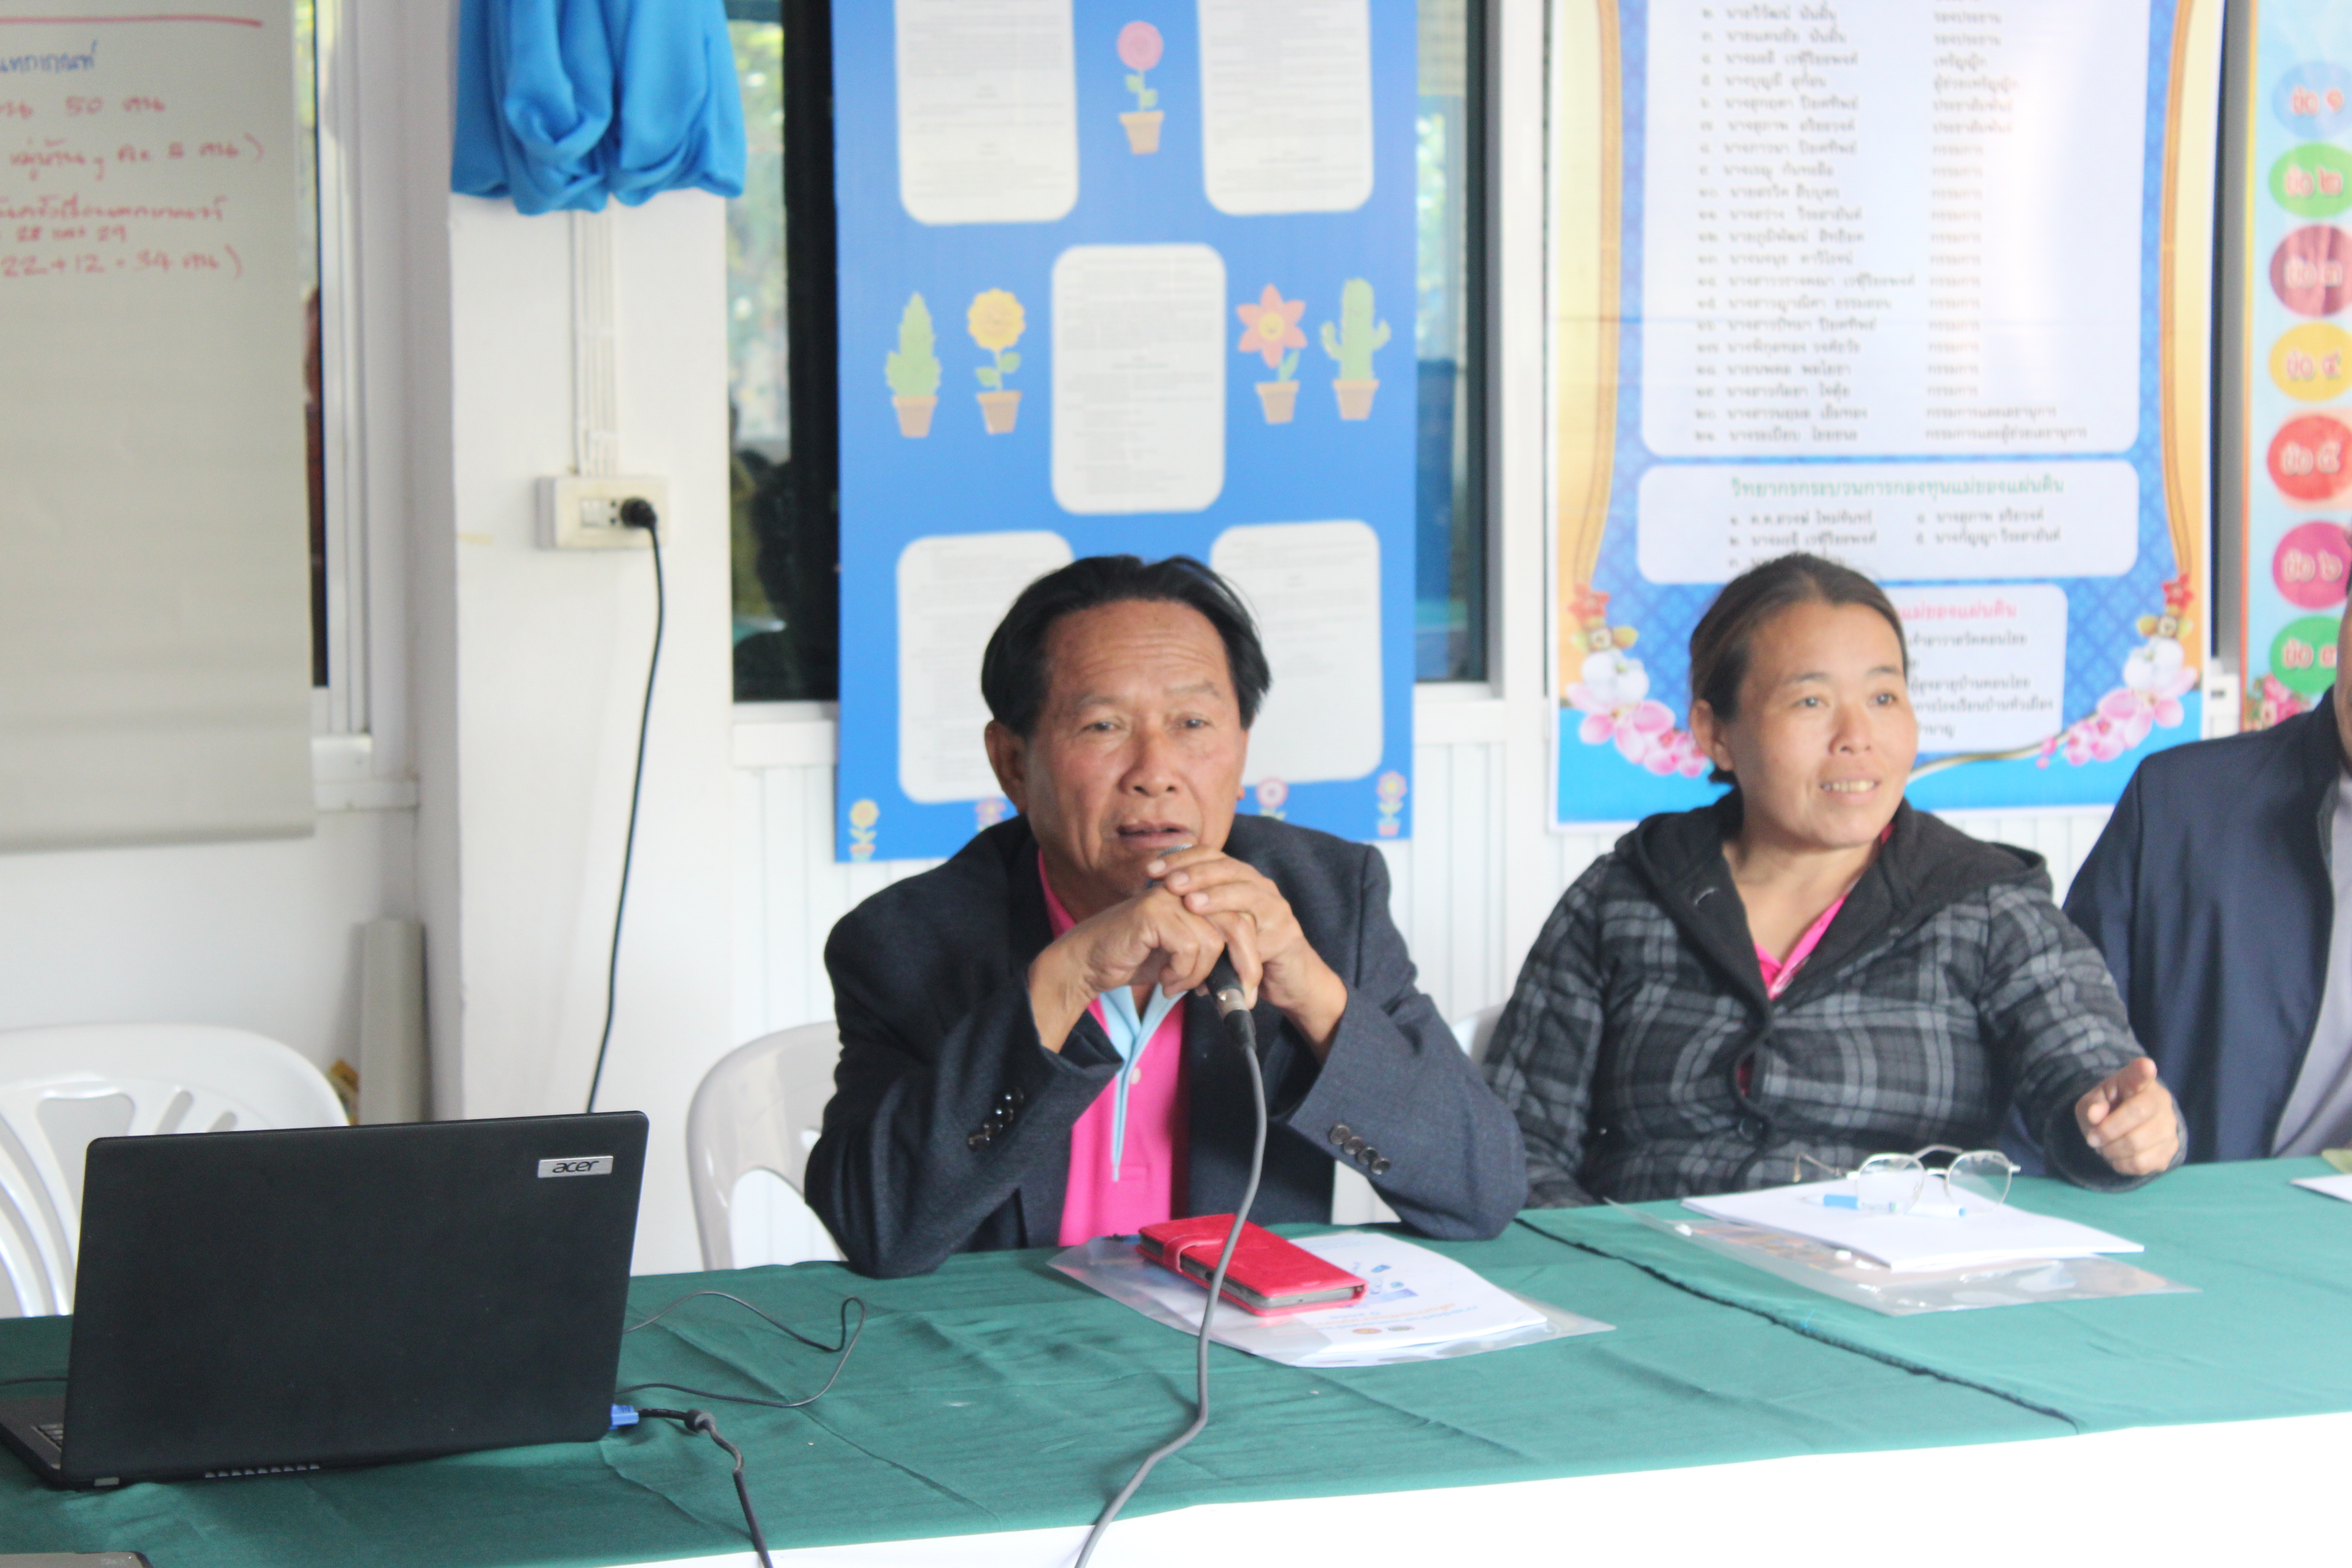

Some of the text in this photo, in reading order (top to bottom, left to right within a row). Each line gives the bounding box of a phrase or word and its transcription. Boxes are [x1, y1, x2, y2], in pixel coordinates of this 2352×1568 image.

[1933, 11, 2002, 24] รองประธาน
[1933, 32, 2001, 47] รองประธาน
[1933, 52, 1987, 73] เหรัญญิก
[1933, 73, 2018, 97] ผู้ช่วยเหรัญญิก
[64, 94, 104, 117] 50
[1932, 96, 2013, 113] ประชาสัมพันธ์
[2292, 84, 2319, 114] ข้อ
[1932, 119, 2013, 134] ประชาสัมพันธ์
[1932, 144, 1984, 156] กรรมการ
[1931, 165, 1984, 178] กรรมการ
[2285, 164, 2314, 196] ข้อ
[1930, 188, 1982, 201] กรรมการ
[1930, 209, 1982, 223] กรรมการ
[1930, 231, 1982, 244] กรรมการ
[1929, 253, 1981, 266] กรรมการ
[1929, 276, 1981, 288] กรรมการ
[1929, 298, 1981, 310] กรรมการ
[1928, 319, 1981, 332] กรรมการ
[1928, 341, 1980, 354] กรรมการ
[1928, 364, 1979, 375] กรรมการ
[1927, 386, 1978, 397] กรรมการ
[1926, 406, 2057, 423] กรรมการและเลขานุการ
[1925, 423, 2087, 445] กรรมการและผู้ช่วยเลขานุการ
[1731, 476, 2064, 501] วิทยากรกระบวนการกองทุนแม่ของแผ่นดิน
[2282, 638, 2314, 669] ข้อ
[553, 1161, 599, 1173] acer
